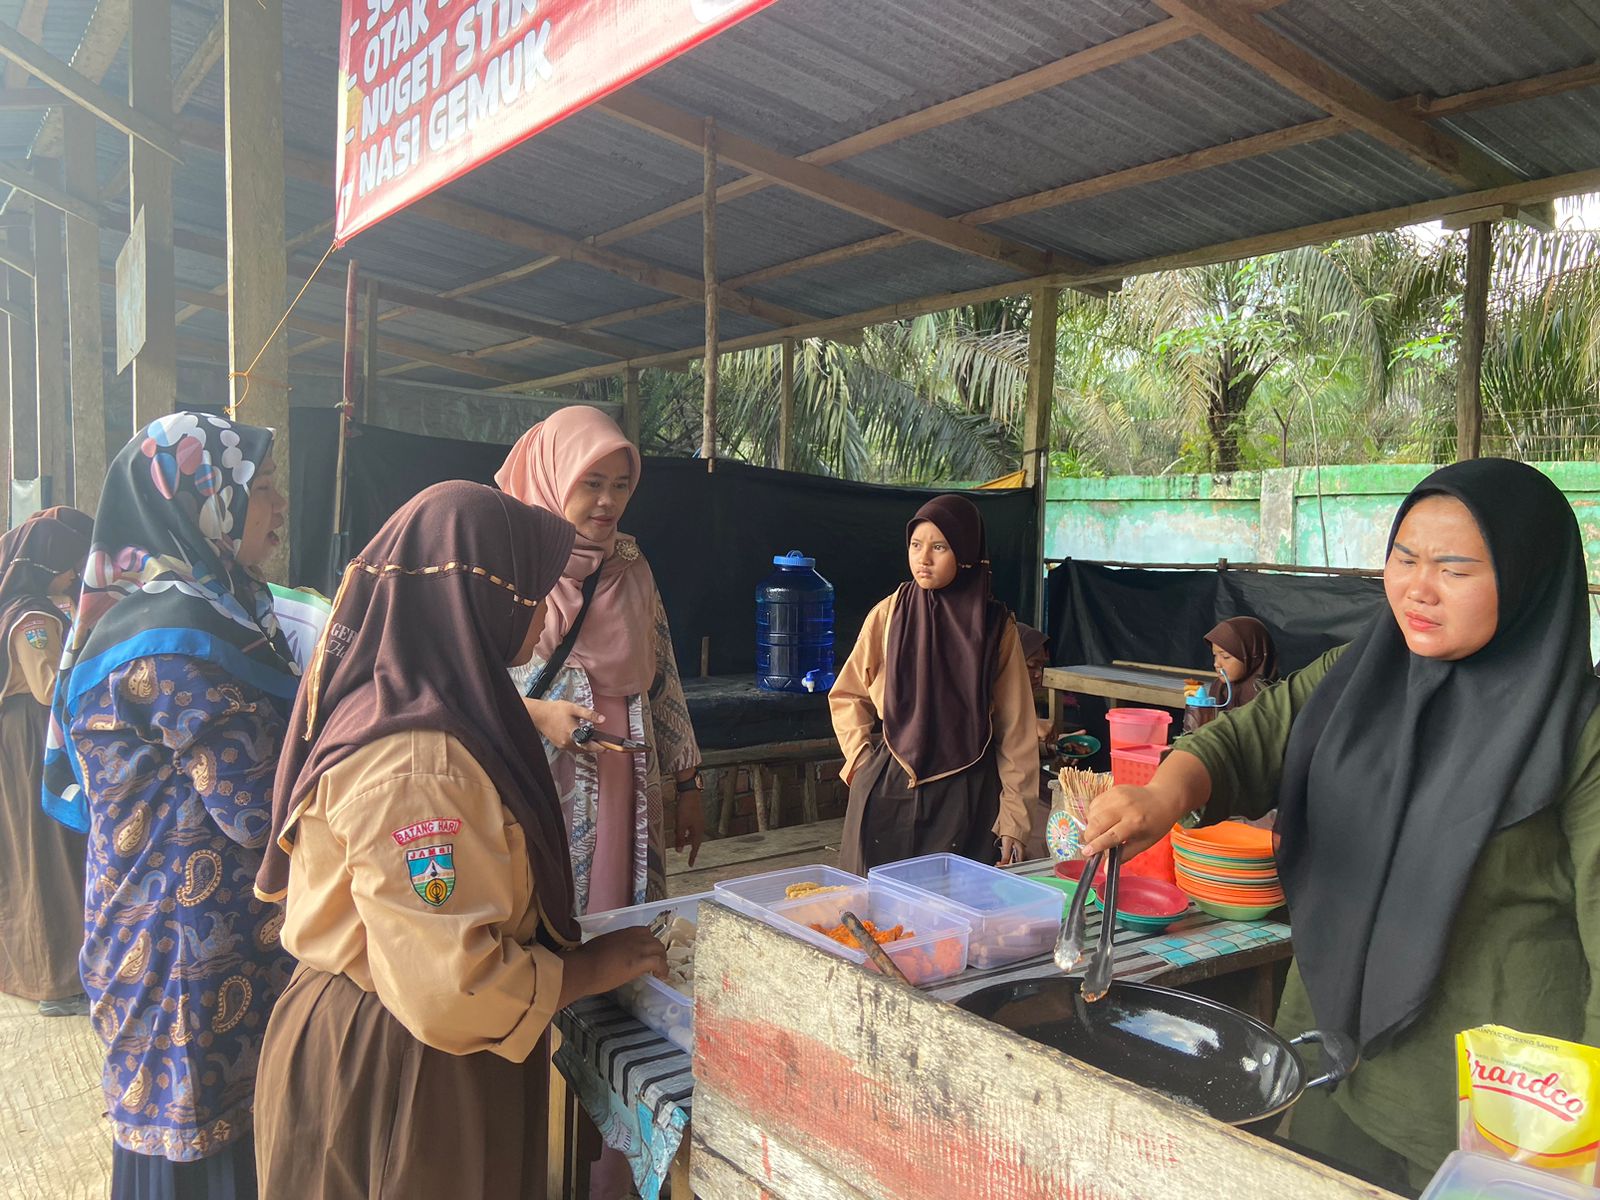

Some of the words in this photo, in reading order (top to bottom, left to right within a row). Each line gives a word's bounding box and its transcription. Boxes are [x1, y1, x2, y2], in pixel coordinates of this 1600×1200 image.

[363, 0, 430, 84] OTAK
[359, 114, 421, 198] NASI
[428, 19, 552, 151] GEMUK
[361, 28, 448, 142] NUGET
[396, 822, 435, 842] BATANG
[438, 821, 458, 832] HARI
[409, 846, 451, 859] JAMBI
